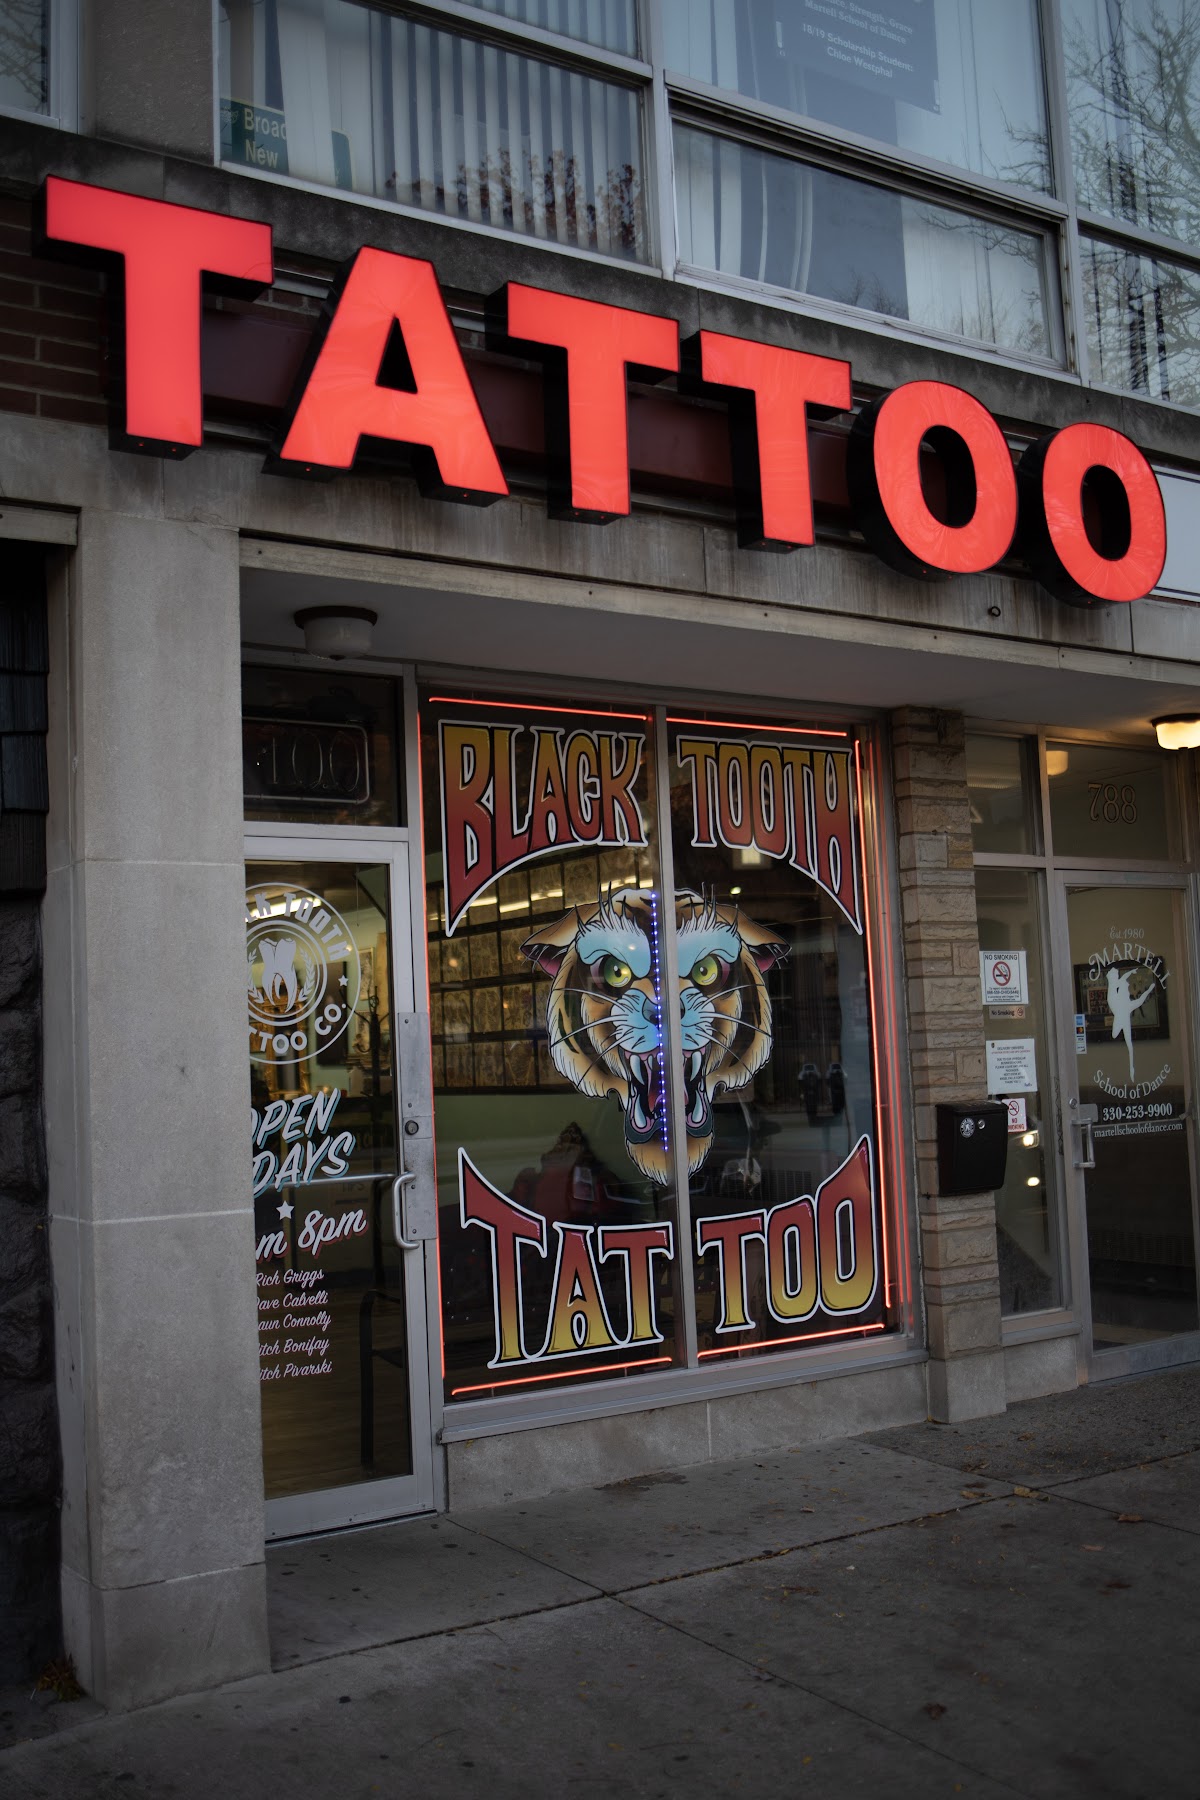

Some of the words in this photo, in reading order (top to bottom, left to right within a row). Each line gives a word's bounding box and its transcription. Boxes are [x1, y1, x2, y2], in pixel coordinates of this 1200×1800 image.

[838, 11, 868, 30] School
[870, 25, 879, 33] of
[880, 27, 907, 45] Dance
[889, 18, 913, 35] Grace
[802, 23, 825, 39] 18/19
[827, 33, 876, 59] Scholarship
[878, 51, 914, 72] Student:
[827, 46, 852, 63] Chloe
[854, 56, 893, 78] Westphal
[245, 138, 279, 169] New
[45, 174, 1168, 603] TATTOO
[1087, 782, 1137, 825] 788
[438, 720, 649, 937] BLACK
[676, 735, 863, 936] TOOTH
[283, 892, 351, 962] TOOTH
[1123, 927, 1145, 940] 1980
[1088, 942, 1171, 990] MARTELL
[314, 1003, 347, 1036] CO.
[1093, 1069, 1128, 1099] School
[1129, 1083, 1141, 1099] of
[1141, 1063, 1171, 1097] Dance
[1102, 1102, 1173, 1121] 330-253-9900
[1094, 1122, 1183, 1138] martellschoolofdance.com
[252, 1131, 357, 1199] DAYS
[297, 1208, 369, 1260] 8pm
[283, 1268, 325, 1289] Griggs
[283, 1290, 329, 1308] Calvelli
[283, 1310, 332, 1332] Connolly
[259, 1340, 281, 1356] itch
[283, 1335, 330, 1357] Bonifay
[260, 1364, 282, 1381] itch
[283, 1358, 334, 1378] Pivarski
